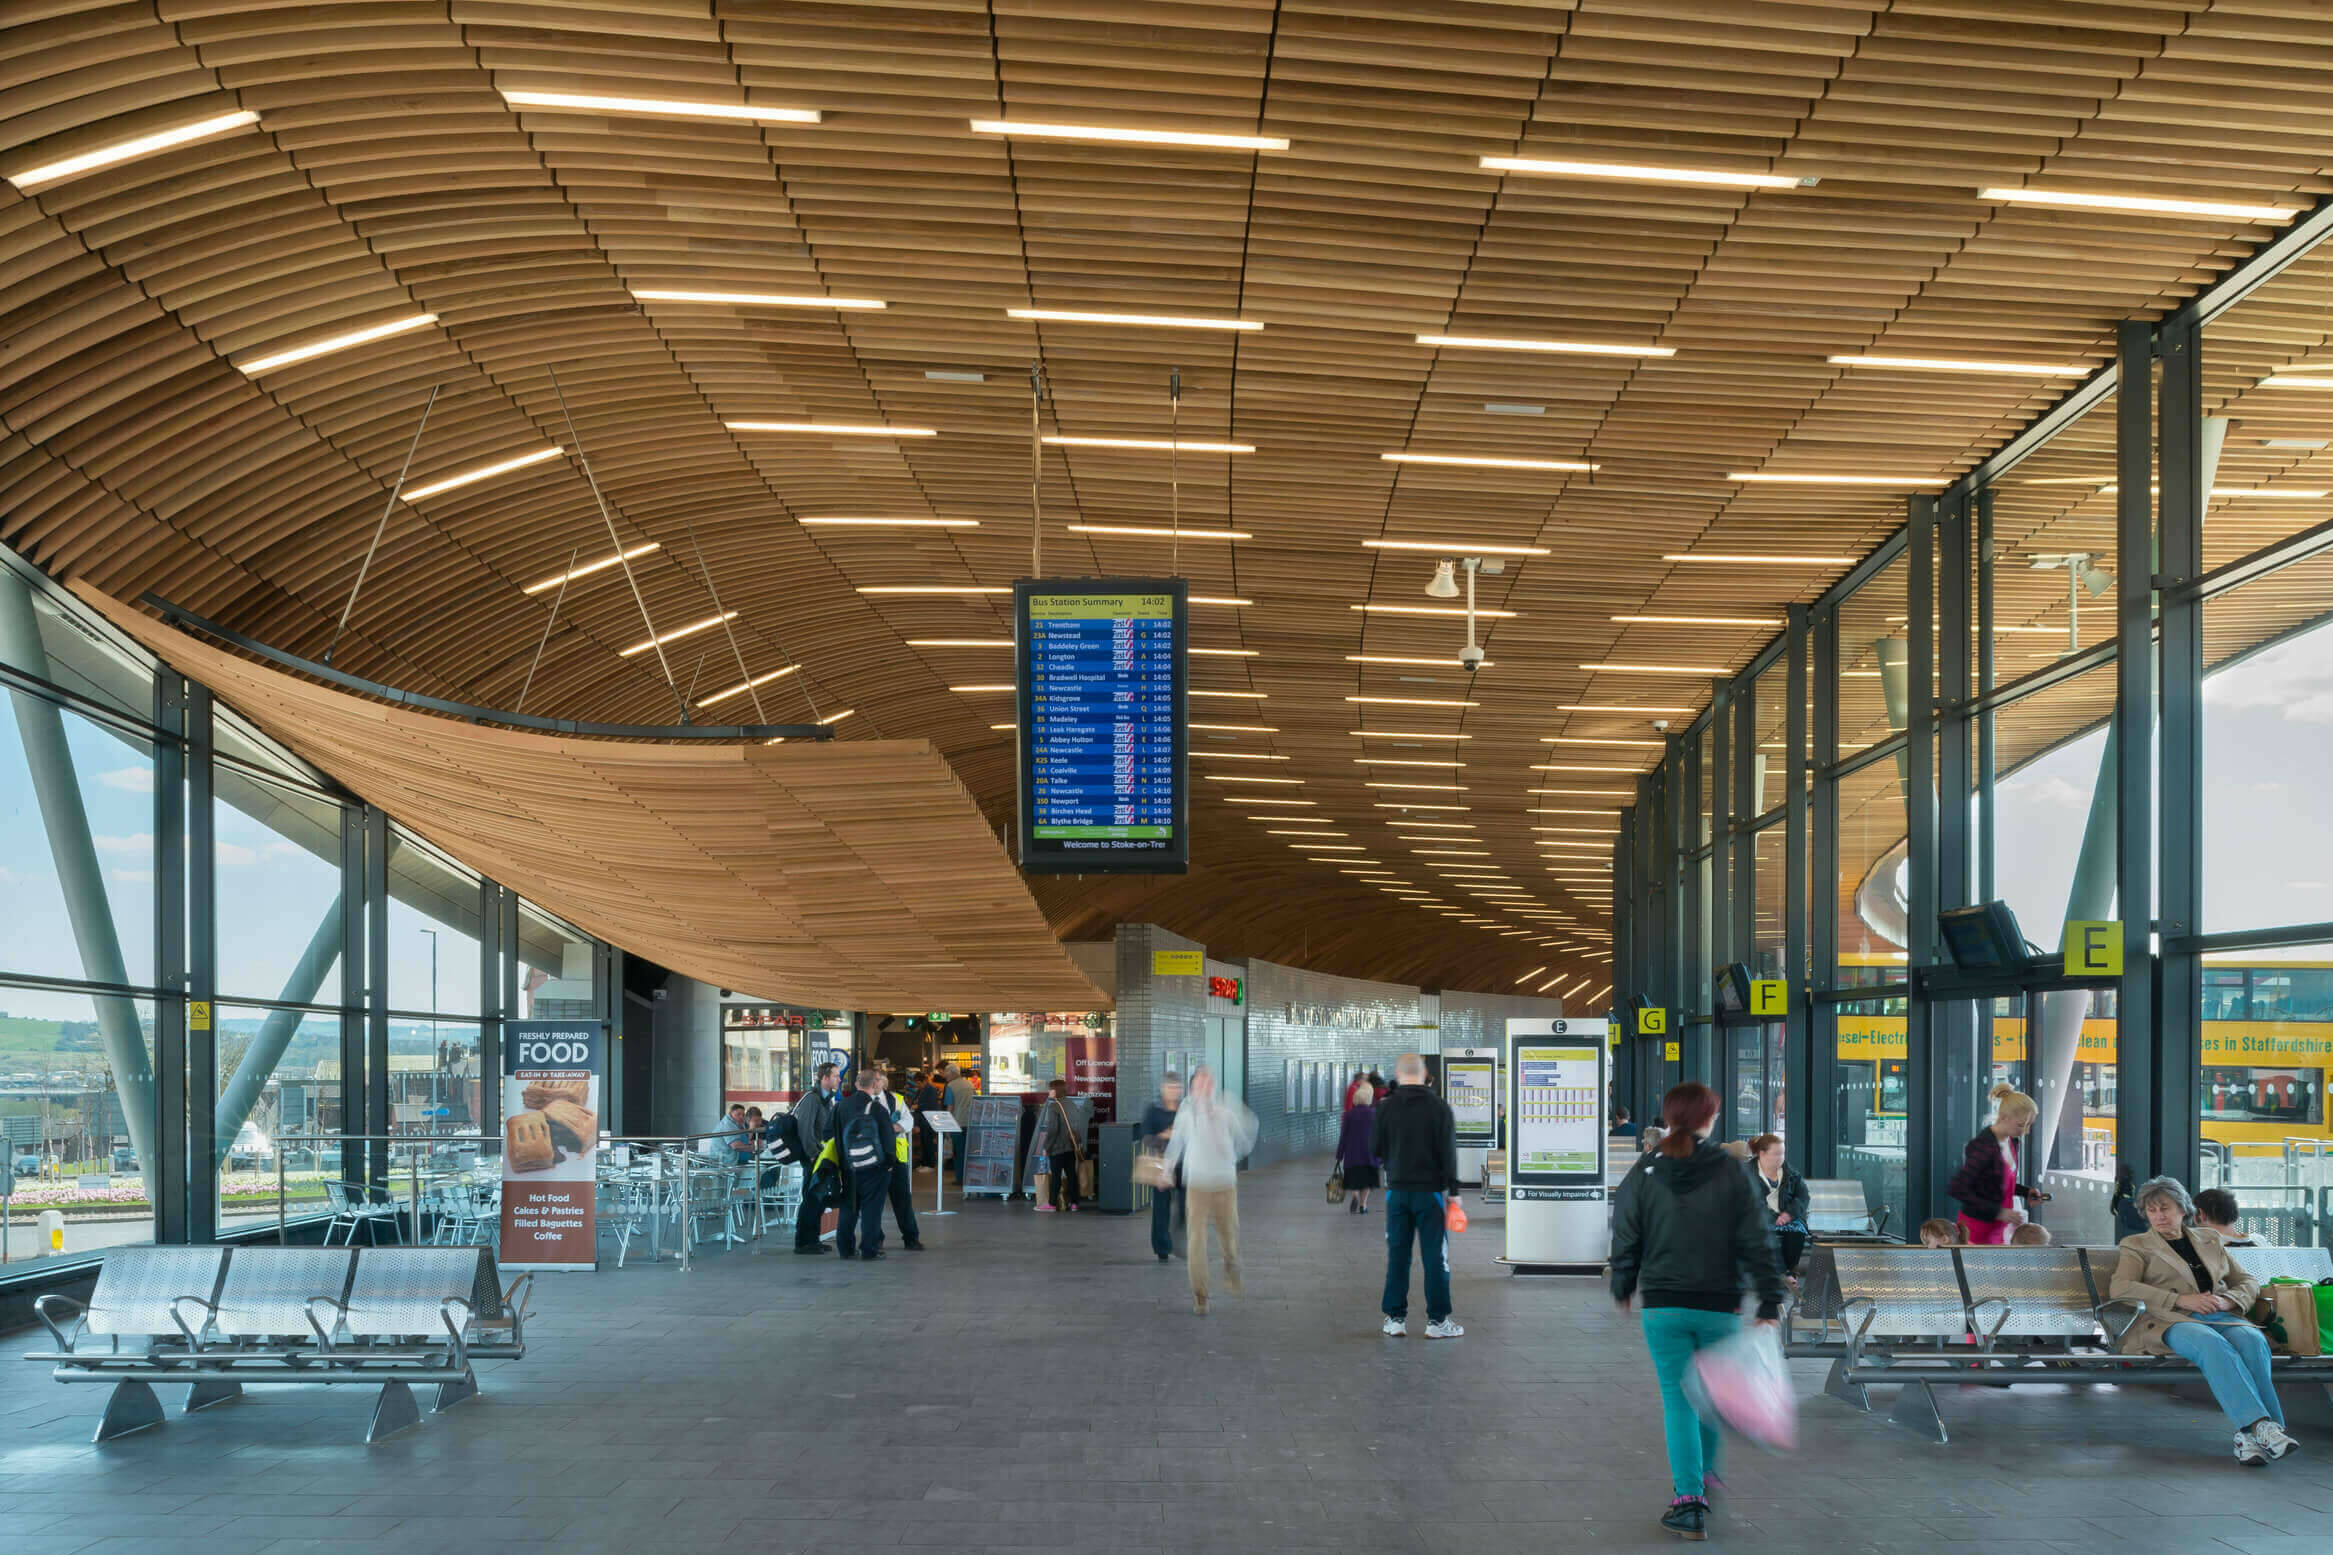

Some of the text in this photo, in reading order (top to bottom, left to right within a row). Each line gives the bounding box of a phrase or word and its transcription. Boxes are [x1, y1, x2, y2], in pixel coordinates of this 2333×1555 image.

[1032, 597, 1165, 607] Bus Station Summary 14:02
[1048, 653, 1075, 661] Longton
[1079, 674, 1106, 682] Hospital
[1049, 695, 1081, 703] Kidsgrove
[1050, 716, 1078, 724] Madeley
[1064, 841, 1099, 849] Welcome
[1101, 841, 1110, 849] to
[2084, 927, 2107, 967] E
[1762, 984, 1777, 1010] F
[741, 1015, 804, 1026] SPAR
[1013, 1015, 1082, 1026] SPAR
[1644, 1010, 1661, 1030] G
[1556, 1022, 1565, 1032] E
[518, 1032, 589, 1040] FRESHLY PREPARED
[2224, 1036, 2237, 1051] in
[2242, 1036, 2332, 1053] Staffordshire
[519, 1042, 589, 1063] FOOD
[1075, 1059, 1114, 1067] Off Licence
[1074, 1075, 1115, 1083] Newspapers
[529, 1193, 570, 1202] Hot Food
[1539, 1191, 1562, 1199] Visually
[1562, 1191, 1590, 1199] Impaired
[513, 1206, 585, 1215] Cakes & Pastries
[514, 1219, 583, 1230] Filled Baguettes
[533, 1231, 563, 1241] Coffee
